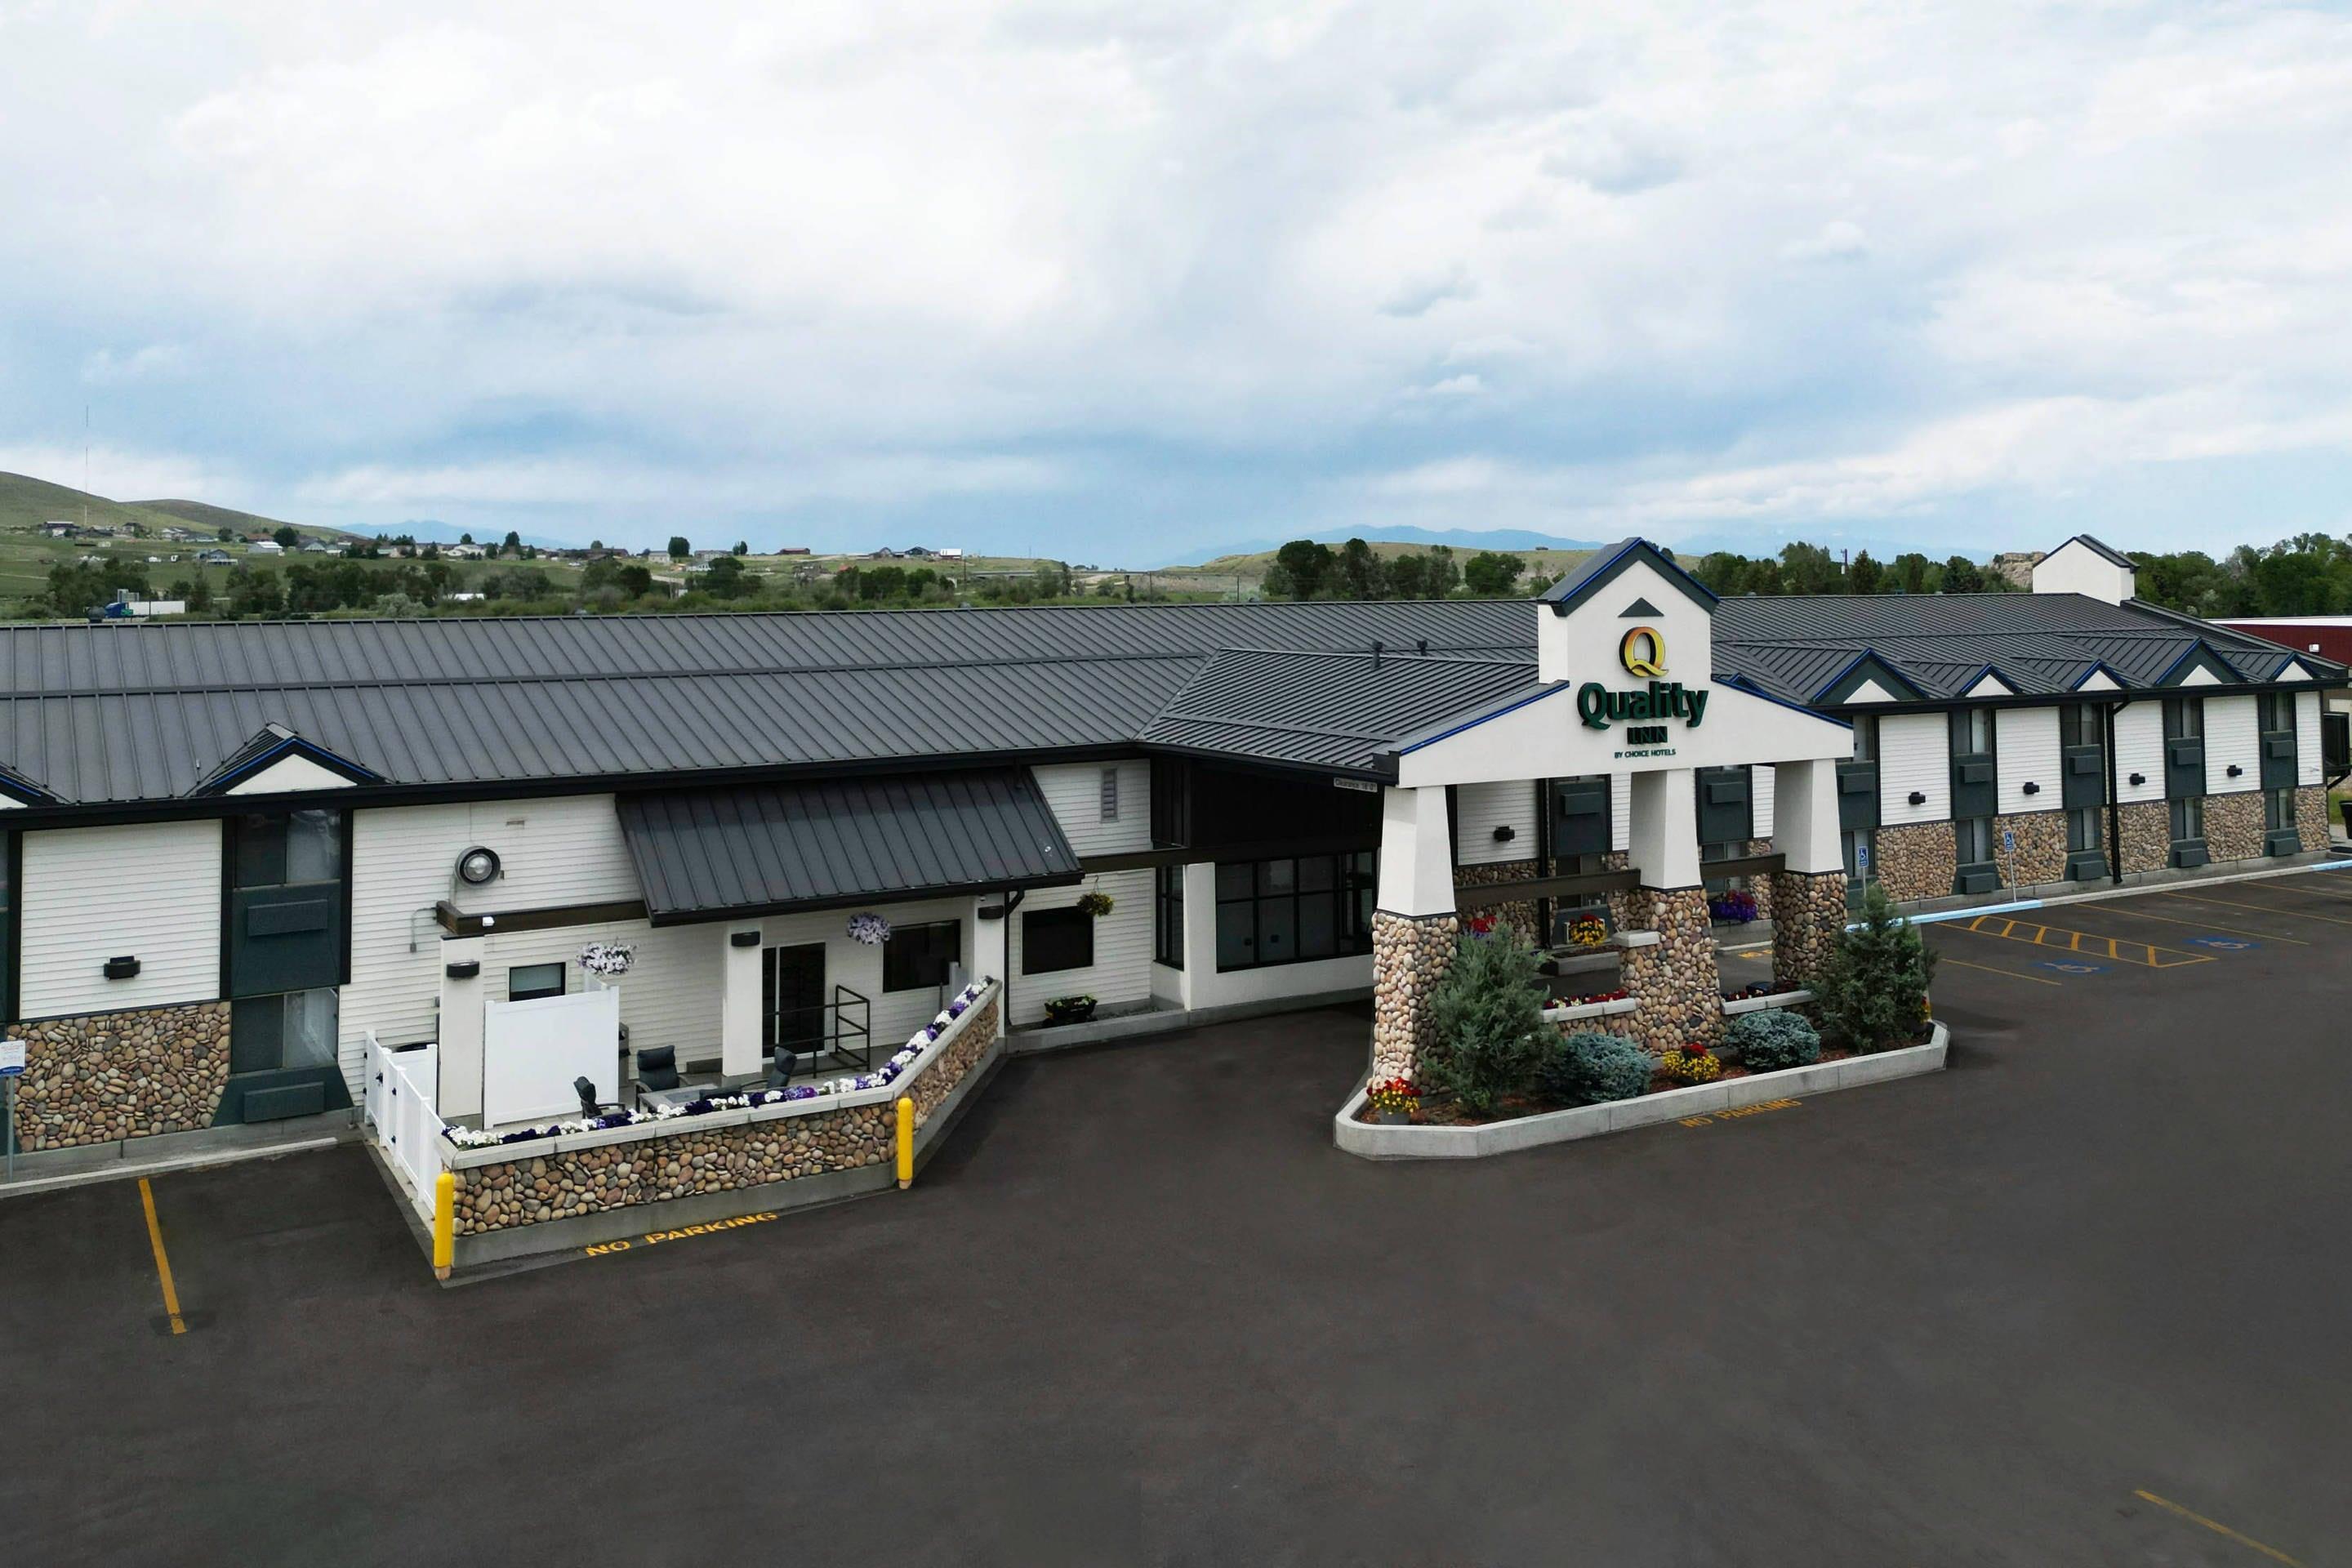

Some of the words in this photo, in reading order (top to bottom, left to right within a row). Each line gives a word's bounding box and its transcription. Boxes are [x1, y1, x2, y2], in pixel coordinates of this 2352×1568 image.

[1619, 626, 1669, 678] Q
[1577, 680, 1709, 730] Quality
[1627, 725, 1668, 745] INN
[1614, 751, 1623, 760] BY
[1624, 750, 1650, 759] CHOICE
[1650, 749, 1677, 757] HOTELS
[1678, 1116, 1713, 1128] NO
[1714, 1098, 1803, 1120] PARKING
[586, 1241, 631, 1257] NO
[644, 1212, 778, 1245] PARKING
